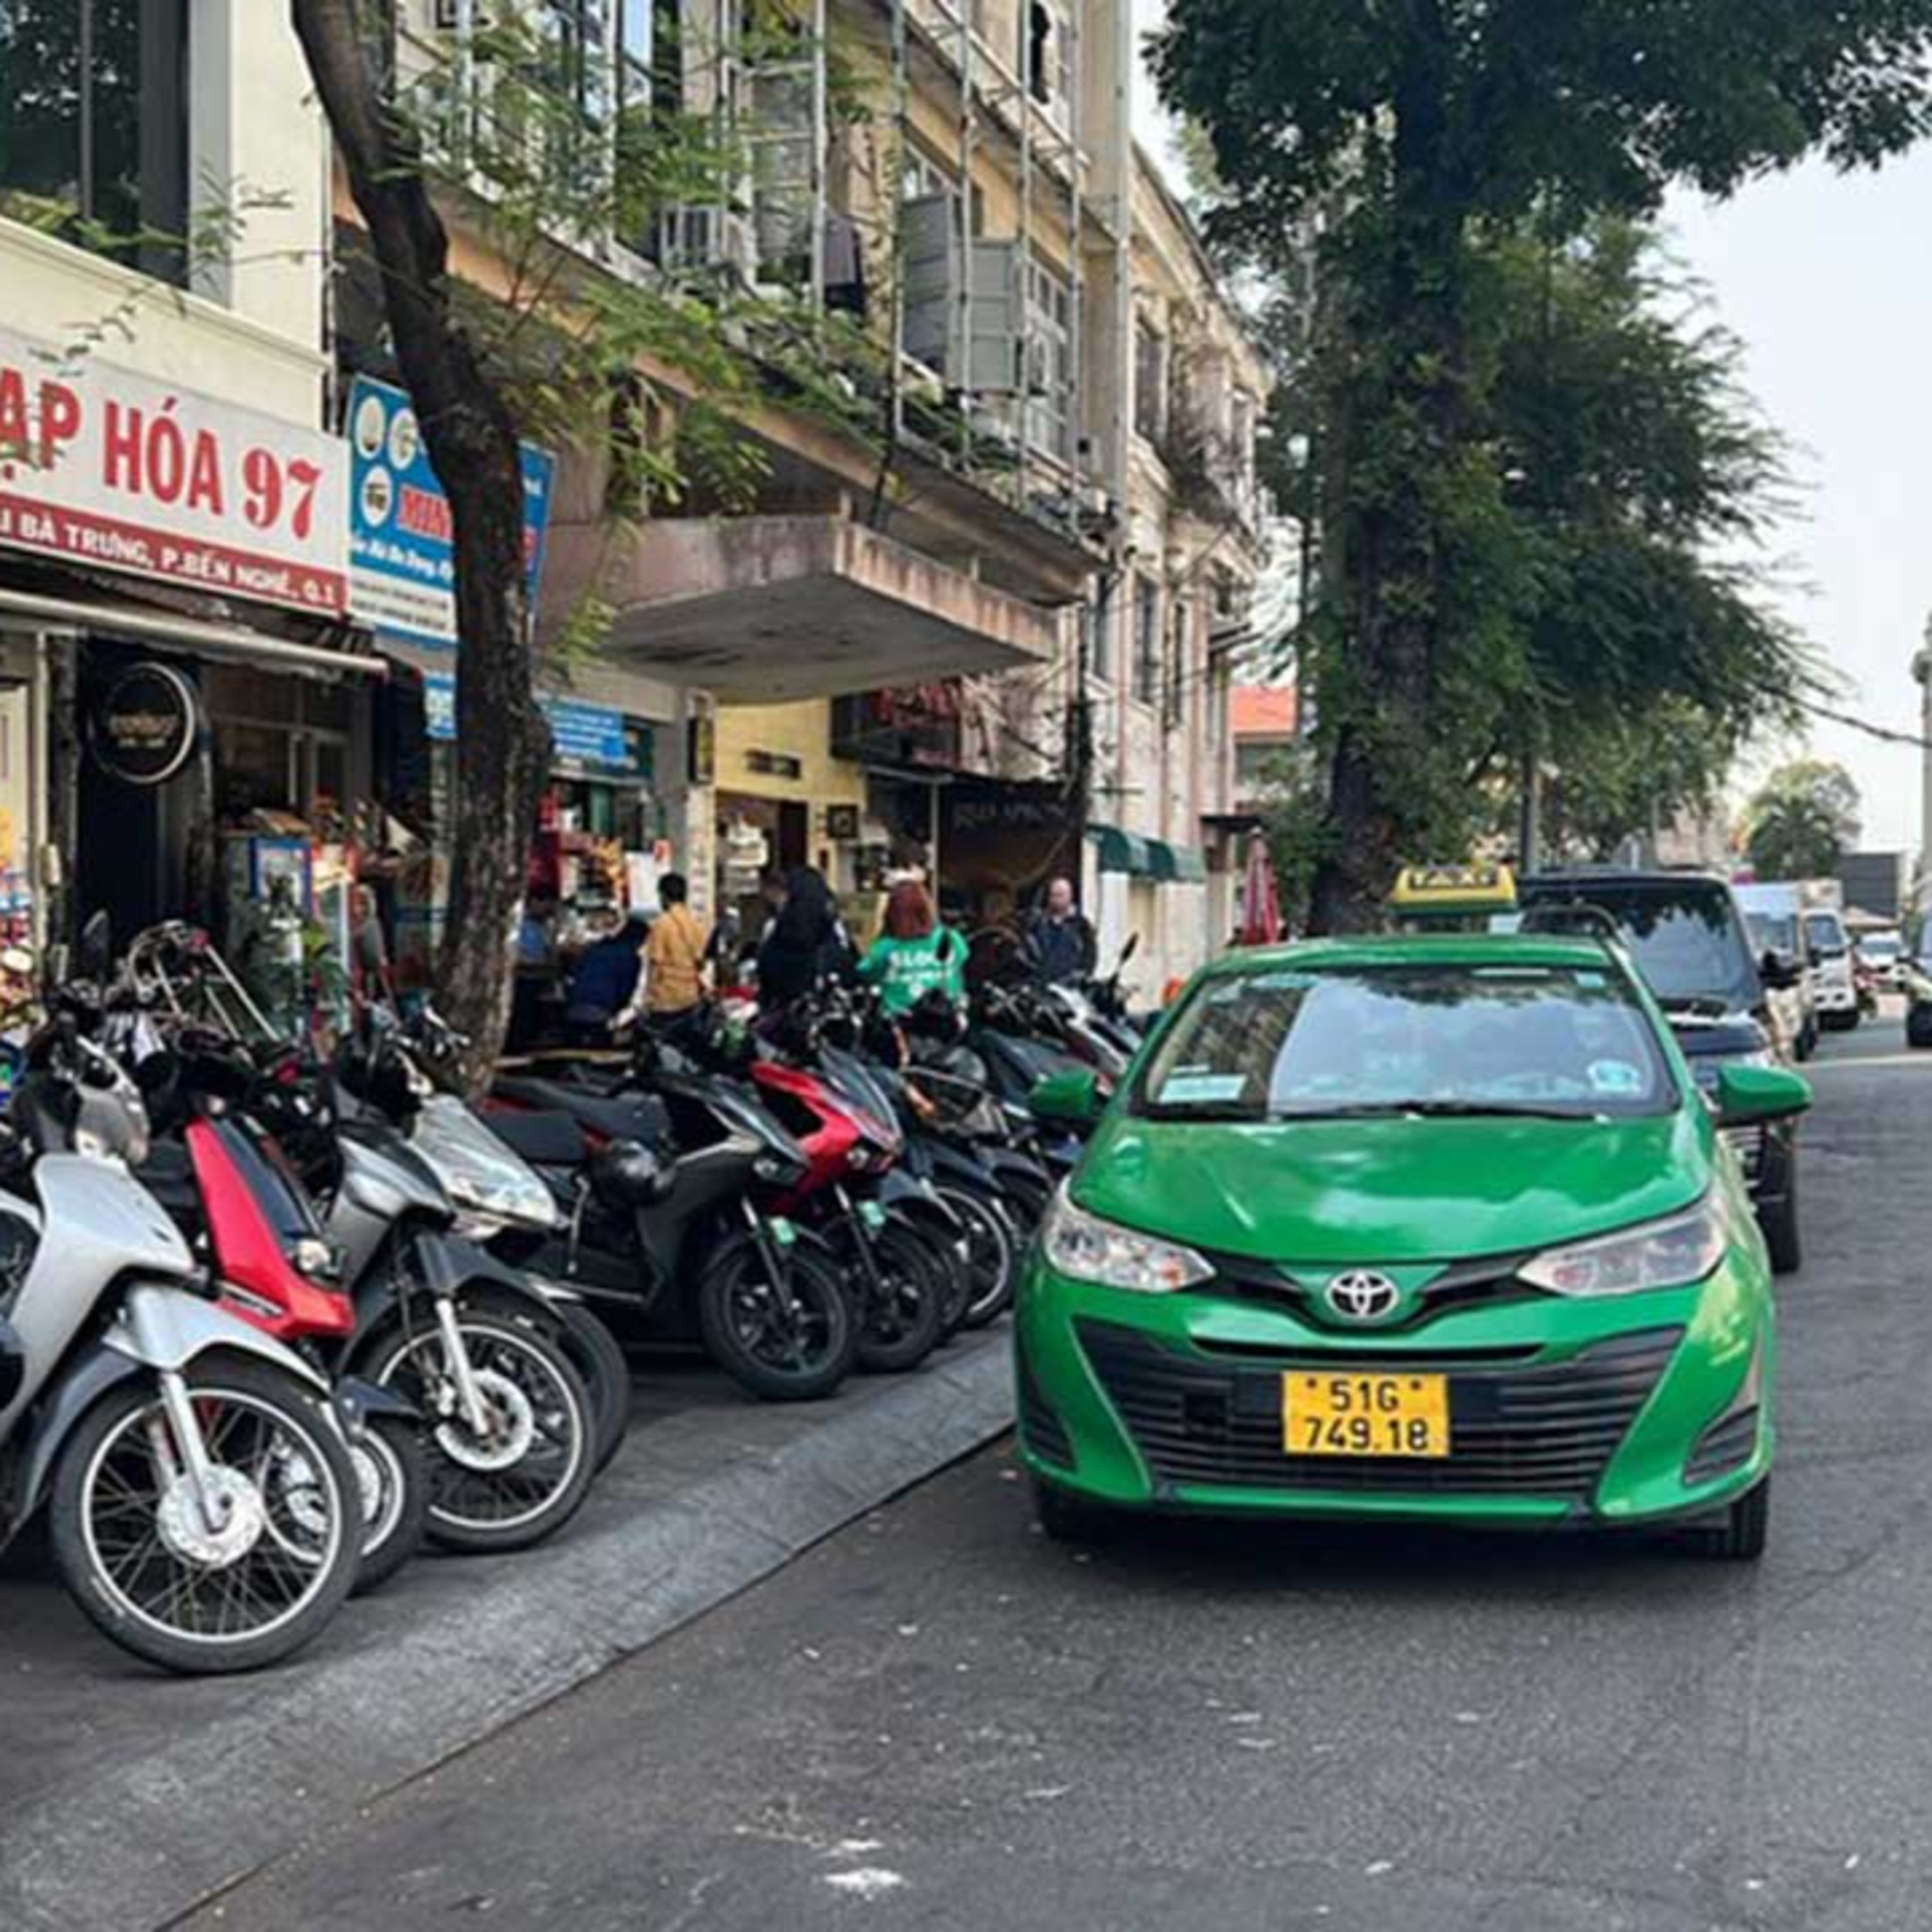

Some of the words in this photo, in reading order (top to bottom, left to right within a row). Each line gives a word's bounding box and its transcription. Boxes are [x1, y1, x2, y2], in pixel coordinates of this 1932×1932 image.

[103, 395, 223, 516] HÓA
[243, 448, 321, 540] 97
[1329, 1379, 1399, 1412] 51G
[1304, 1417, 1429, 1451] 749.18
